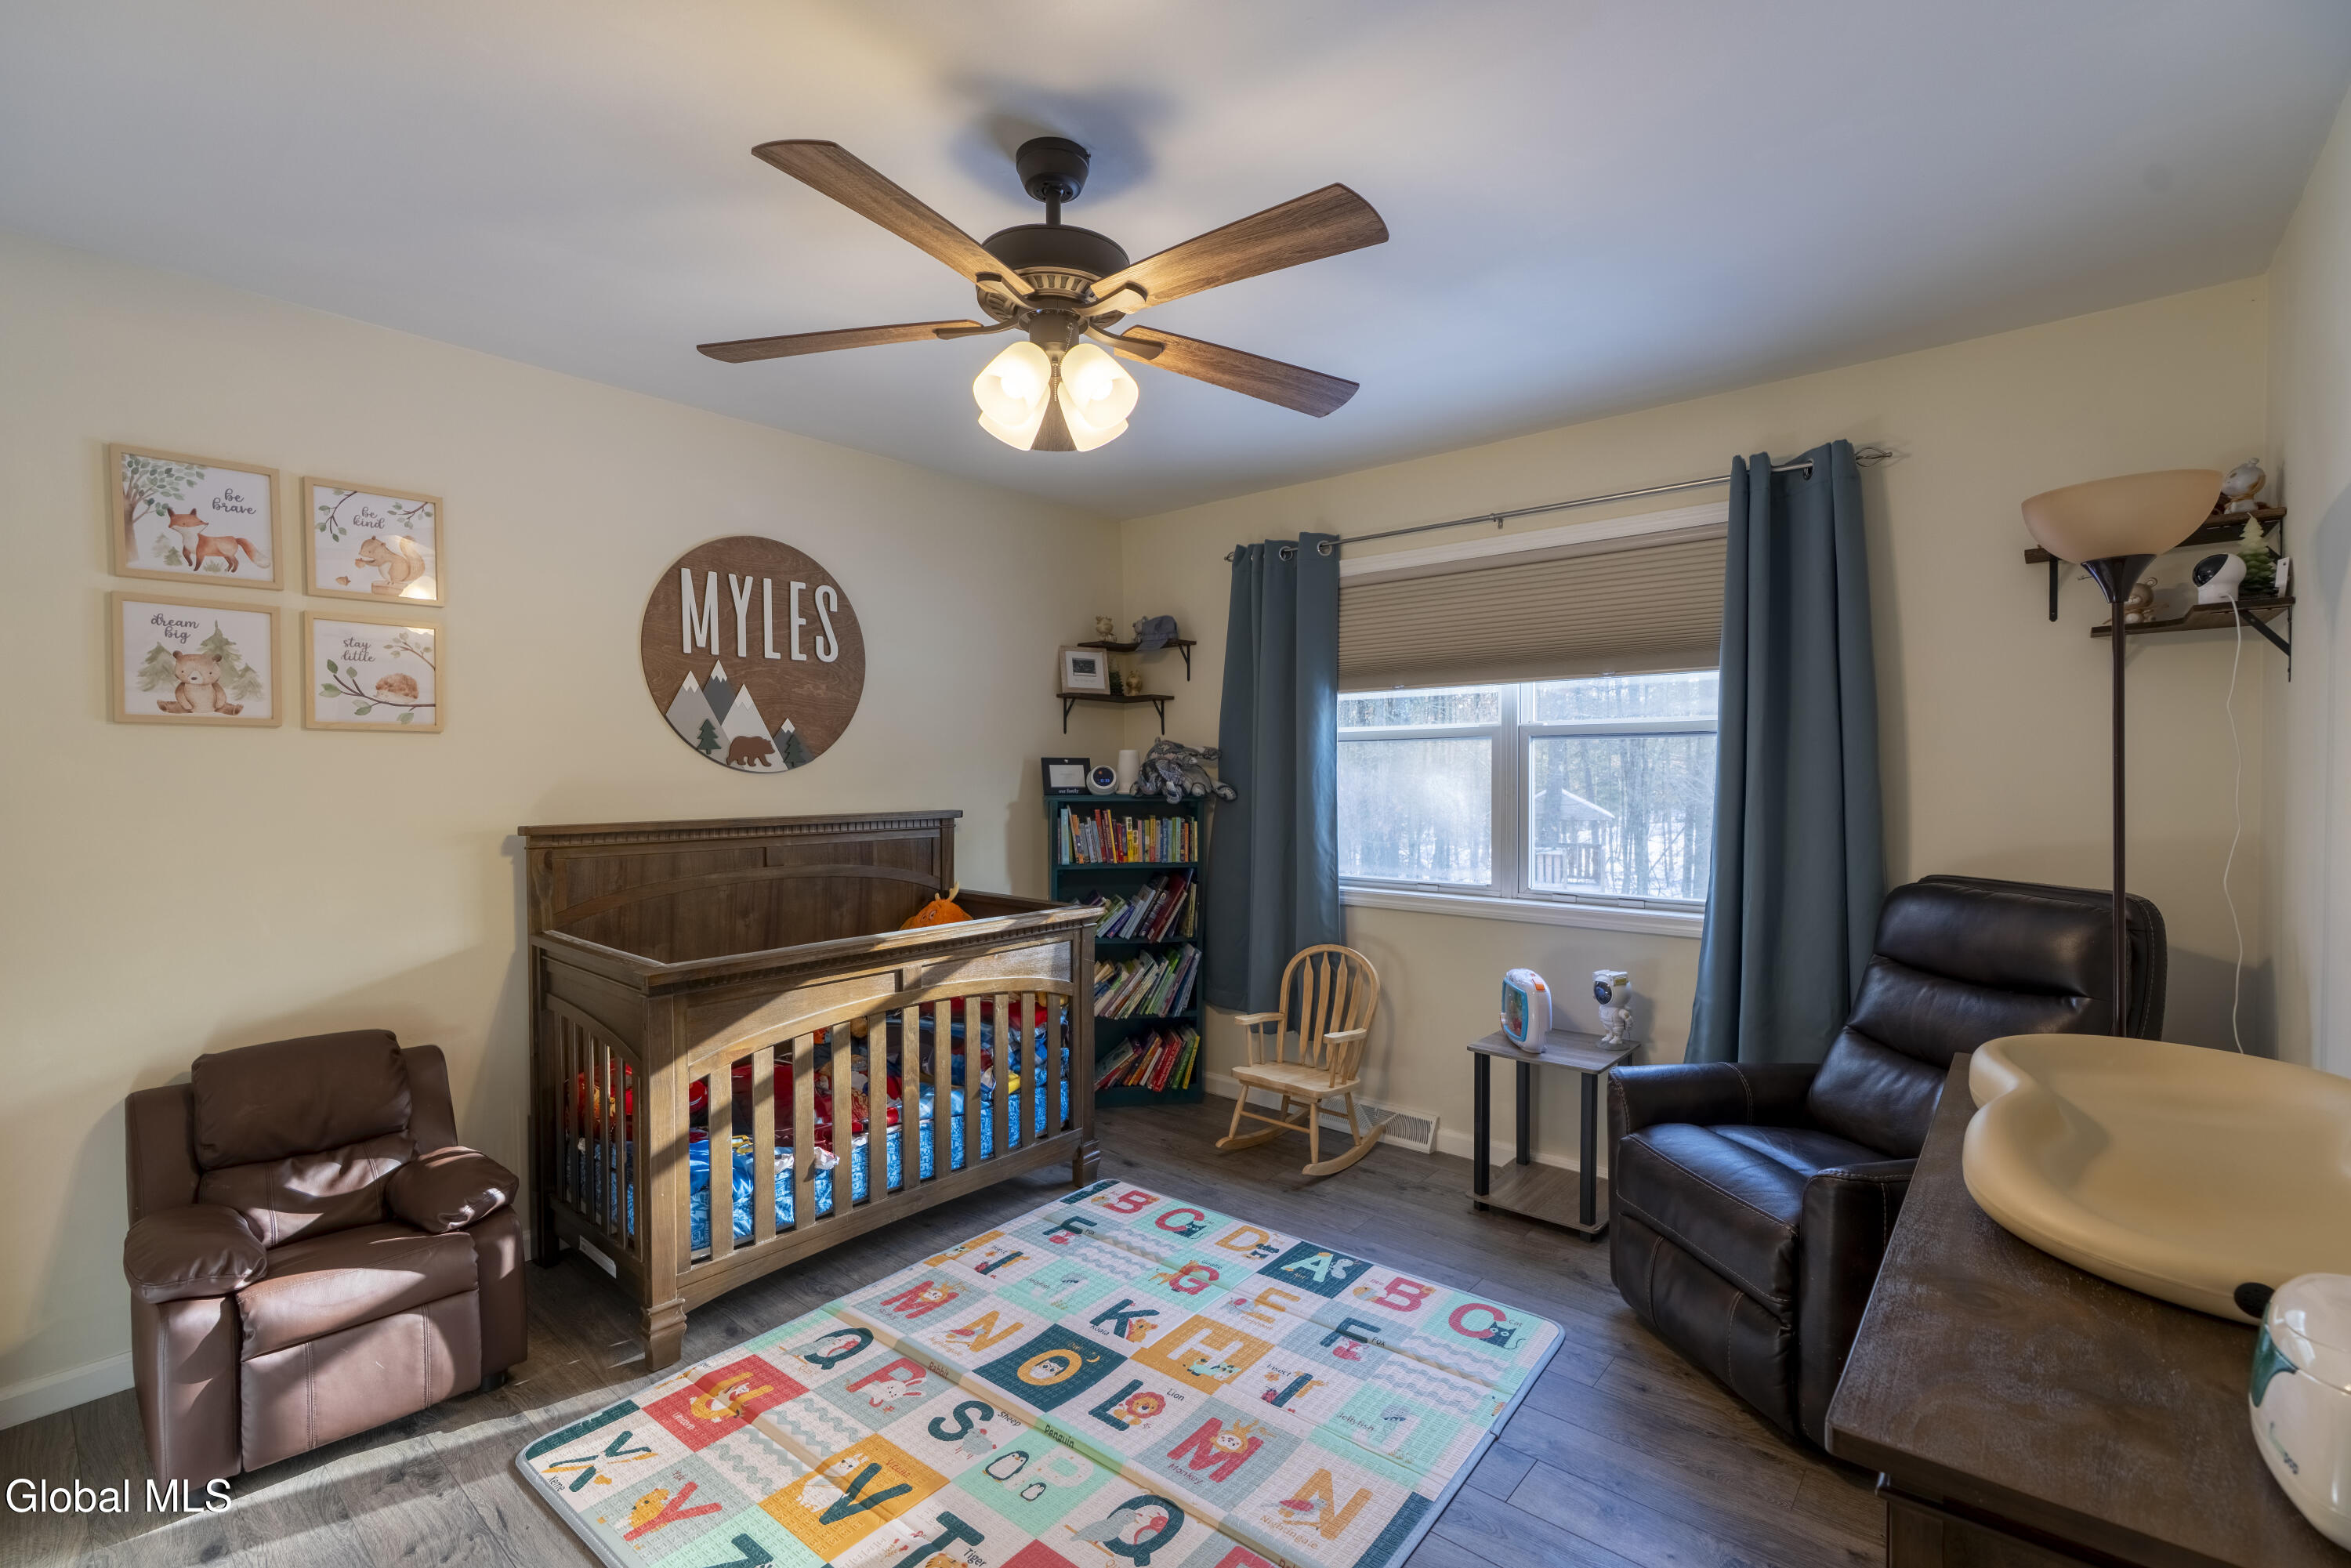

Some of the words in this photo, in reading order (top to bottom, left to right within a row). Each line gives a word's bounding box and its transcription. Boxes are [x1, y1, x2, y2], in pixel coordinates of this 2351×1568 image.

[212, 498, 256, 515] brave
[224, 488, 245, 503] be
[353, 515, 385, 530] kind
[361, 506, 378, 520] be
[150, 613, 199, 629] dream
[680, 567, 839, 663] MYLES
[164, 626, 191, 643] big
[342, 637, 371, 651] stay
[340, 649, 376, 664] little
[1103, 1190, 1154, 1214] B
[1155, 1208, 1205, 1233] C
[1215, 1225, 1270, 1252] D
[1281, 1251, 1334, 1283] A
[1169, 1264, 1220, 1295] G
[1371, 1276, 1429, 1313] B
[1089, 1298, 1161, 1338] K
[1448, 1303, 1507, 1338] C
[1166, 1327, 1244, 1367] H
[929, 1361, 950, 1380] Rabbit
[1017, 1349, 1082, 1385] O
[1088, 1378, 1144, 1432] L
[1166, 1388, 1185, 1402] Lion
[672, 1419, 696, 1439] Unicorn
[928, 1400, 994, 1441] S
[998, 1410, 1021, 1427] Sheep
[1044, 1425, 1074, 1449] Penguin
[1166, 1417, 1264, 1483] M
[547, 1475, 565, 1492] Xeme
[1168, 1463, 1204, 1485] Monkey
[819, 1463, 913, 1526] V
[1291, 1468, 1373, 1541] N
[623, 1482, 723, 1541] Y
[1103, 1494, 1185, 1567] Q
[963, 1548, 987, 1567] Tiger
